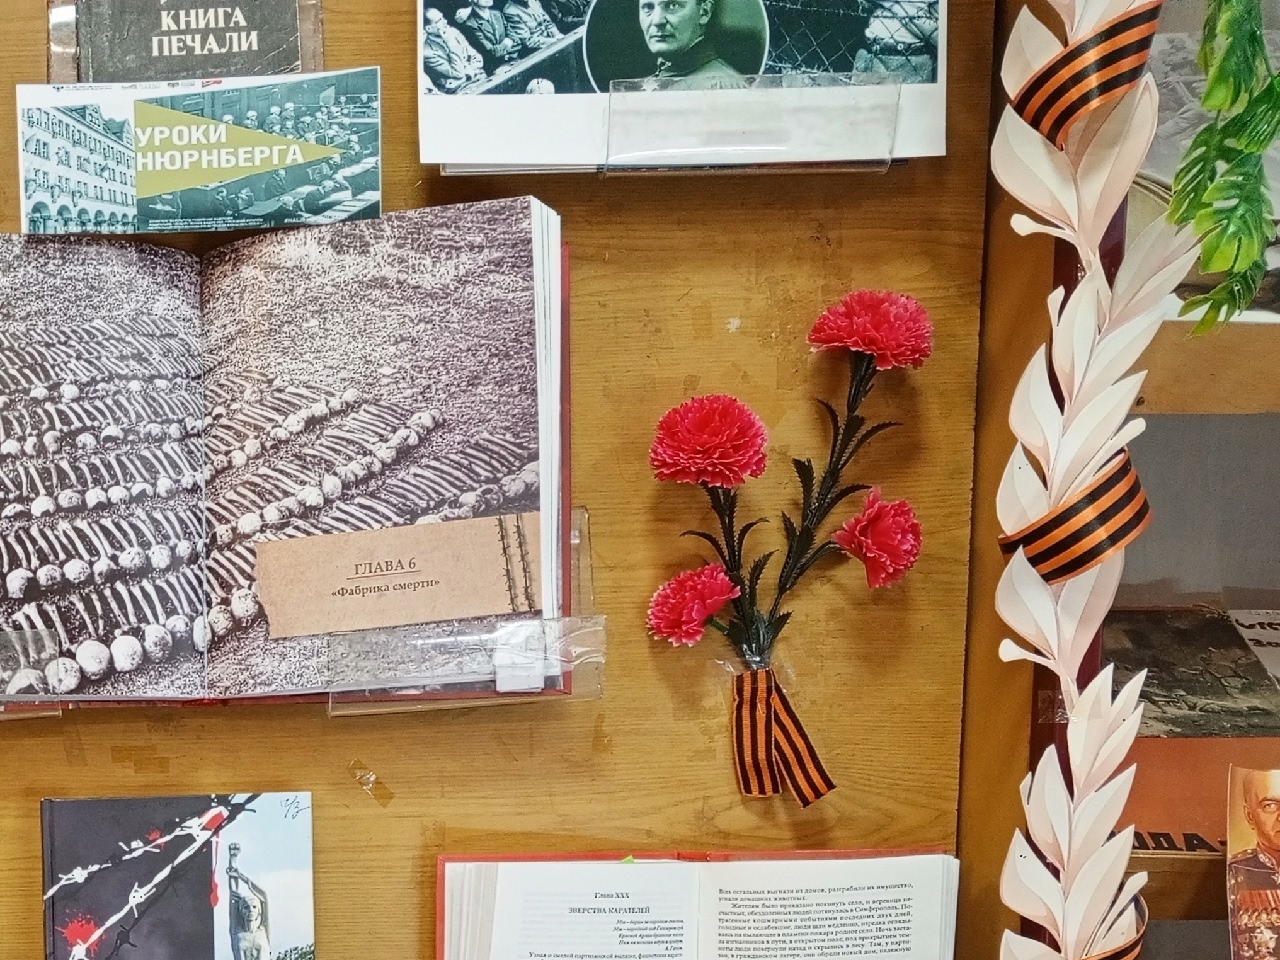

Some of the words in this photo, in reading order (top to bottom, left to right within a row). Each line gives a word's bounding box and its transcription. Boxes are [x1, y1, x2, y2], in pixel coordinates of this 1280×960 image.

[160, 8, 247, 31] КНИГА
[151, 31, 259, 57] ПЕЧАЛИ
[137, 123, 227, 148] УРОКИ
[136, 144, 304, 172] НЮРНБЕРГА
[354, 559, 404, 575] ГЛАВА
[408, 557, 417, 569] 6
[331, 583, 389, 598] «Фабрика
[392, 578, 440, 593] смерти»
